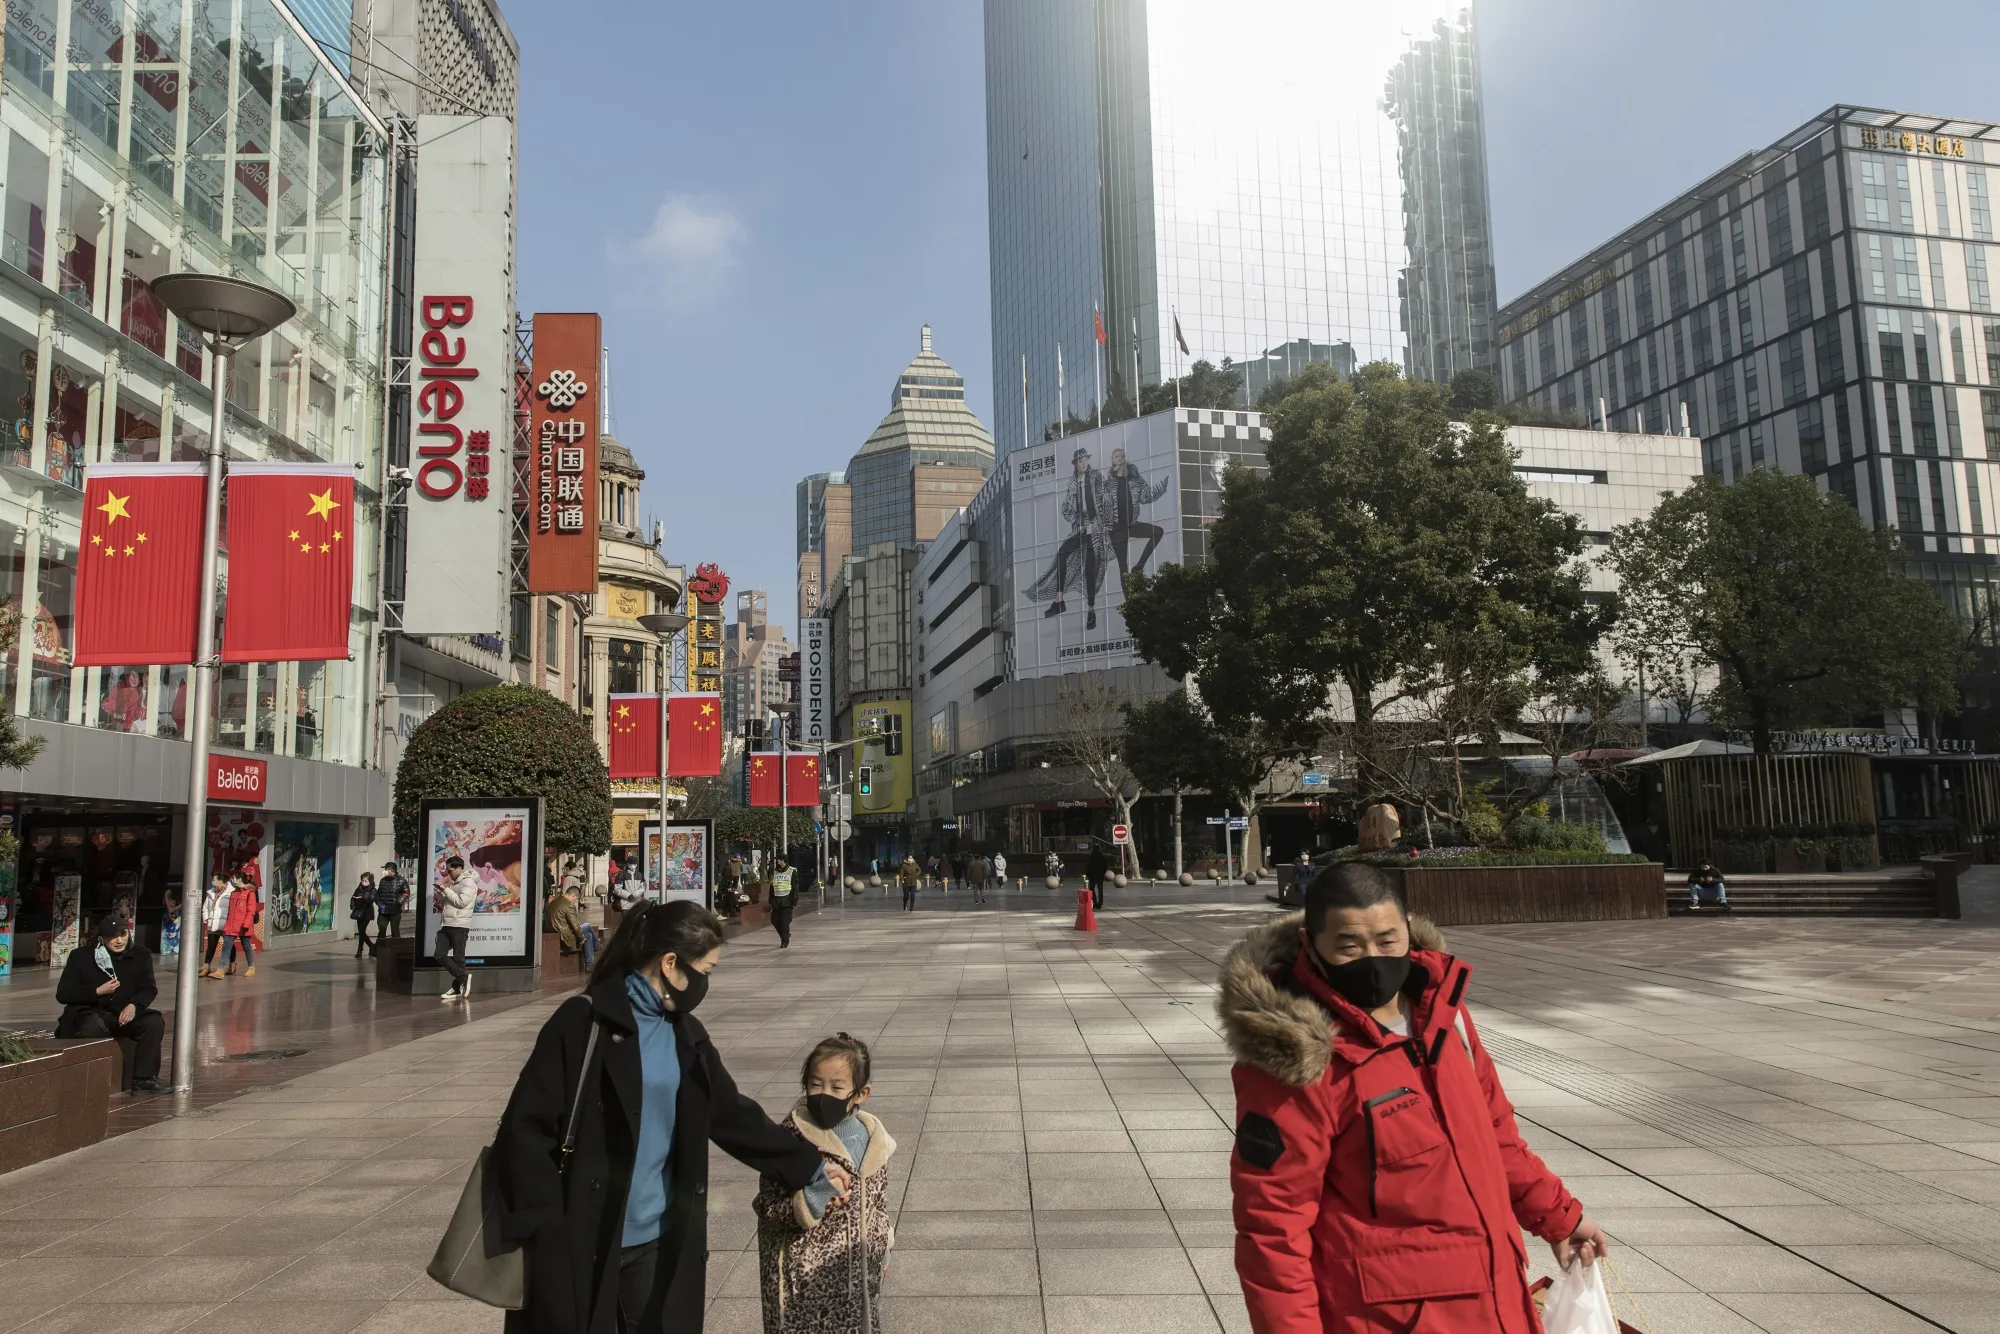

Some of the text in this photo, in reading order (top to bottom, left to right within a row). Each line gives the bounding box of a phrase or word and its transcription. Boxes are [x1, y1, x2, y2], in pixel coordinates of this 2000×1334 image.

[6, 1, 47, 41] Baleno
[82, 0, 121, 36] Baleno
[212, 69, 229, 90] Bale
[189, 96, 215, 125] Baleno
[238, 98, 264, 127] Baleno
[282, 192, 303, 216] Baleno
[418, 296, 479, 498] Baleno
[466, 429, 491, 500] 班尼路
[557, 418, 585, 529] 中国联通
[1019, 455, 1055, 475] 波司登
[540, 469, 555, 530] unicom
[808, 630, 822, 638] 名牌
[809, 640, 822, 736] BOSIDENG
[217, 768, 259, 791] Baleno
